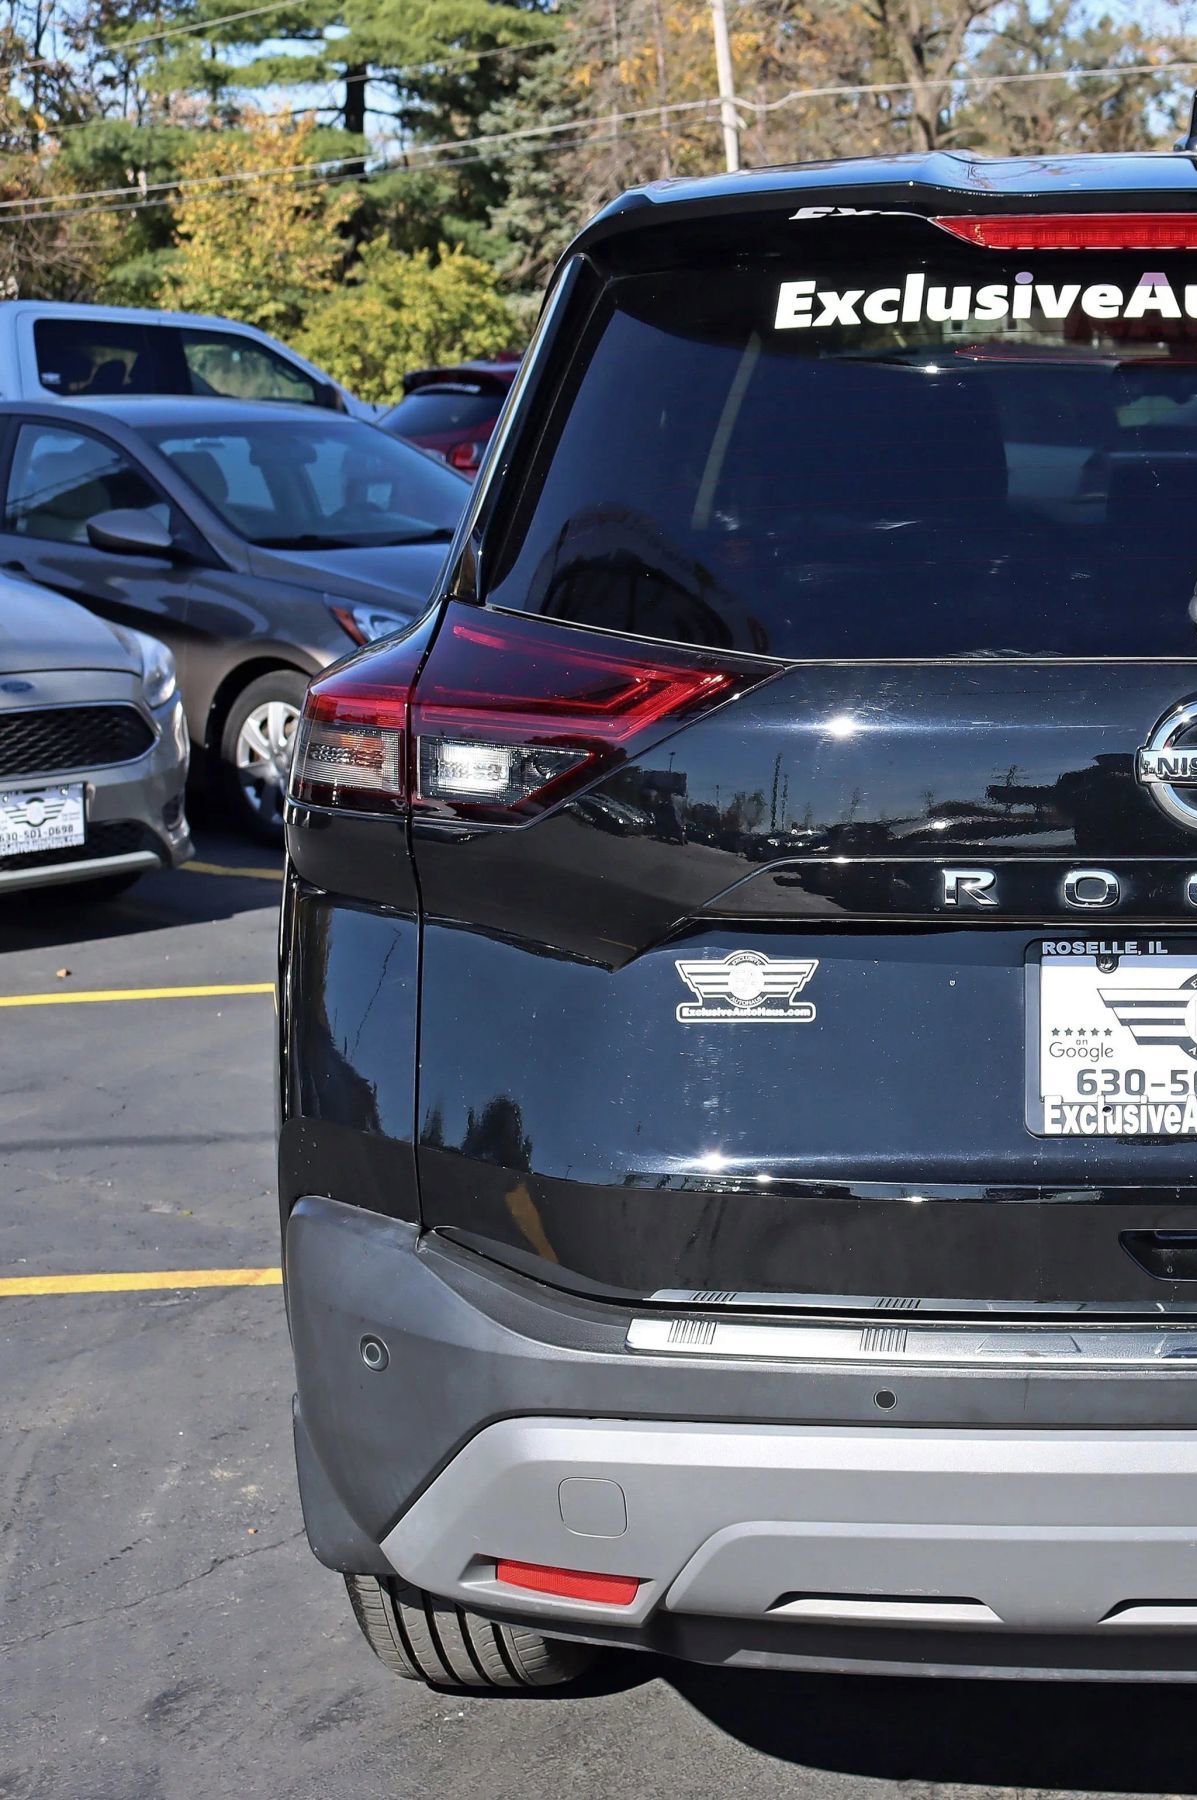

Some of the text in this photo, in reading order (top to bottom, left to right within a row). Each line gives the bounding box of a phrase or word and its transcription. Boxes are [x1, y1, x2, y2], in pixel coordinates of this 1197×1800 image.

[1041, 940, 1168, 955] ROSELLE, IL
[1049, 1041, 1114, 1062] Google
